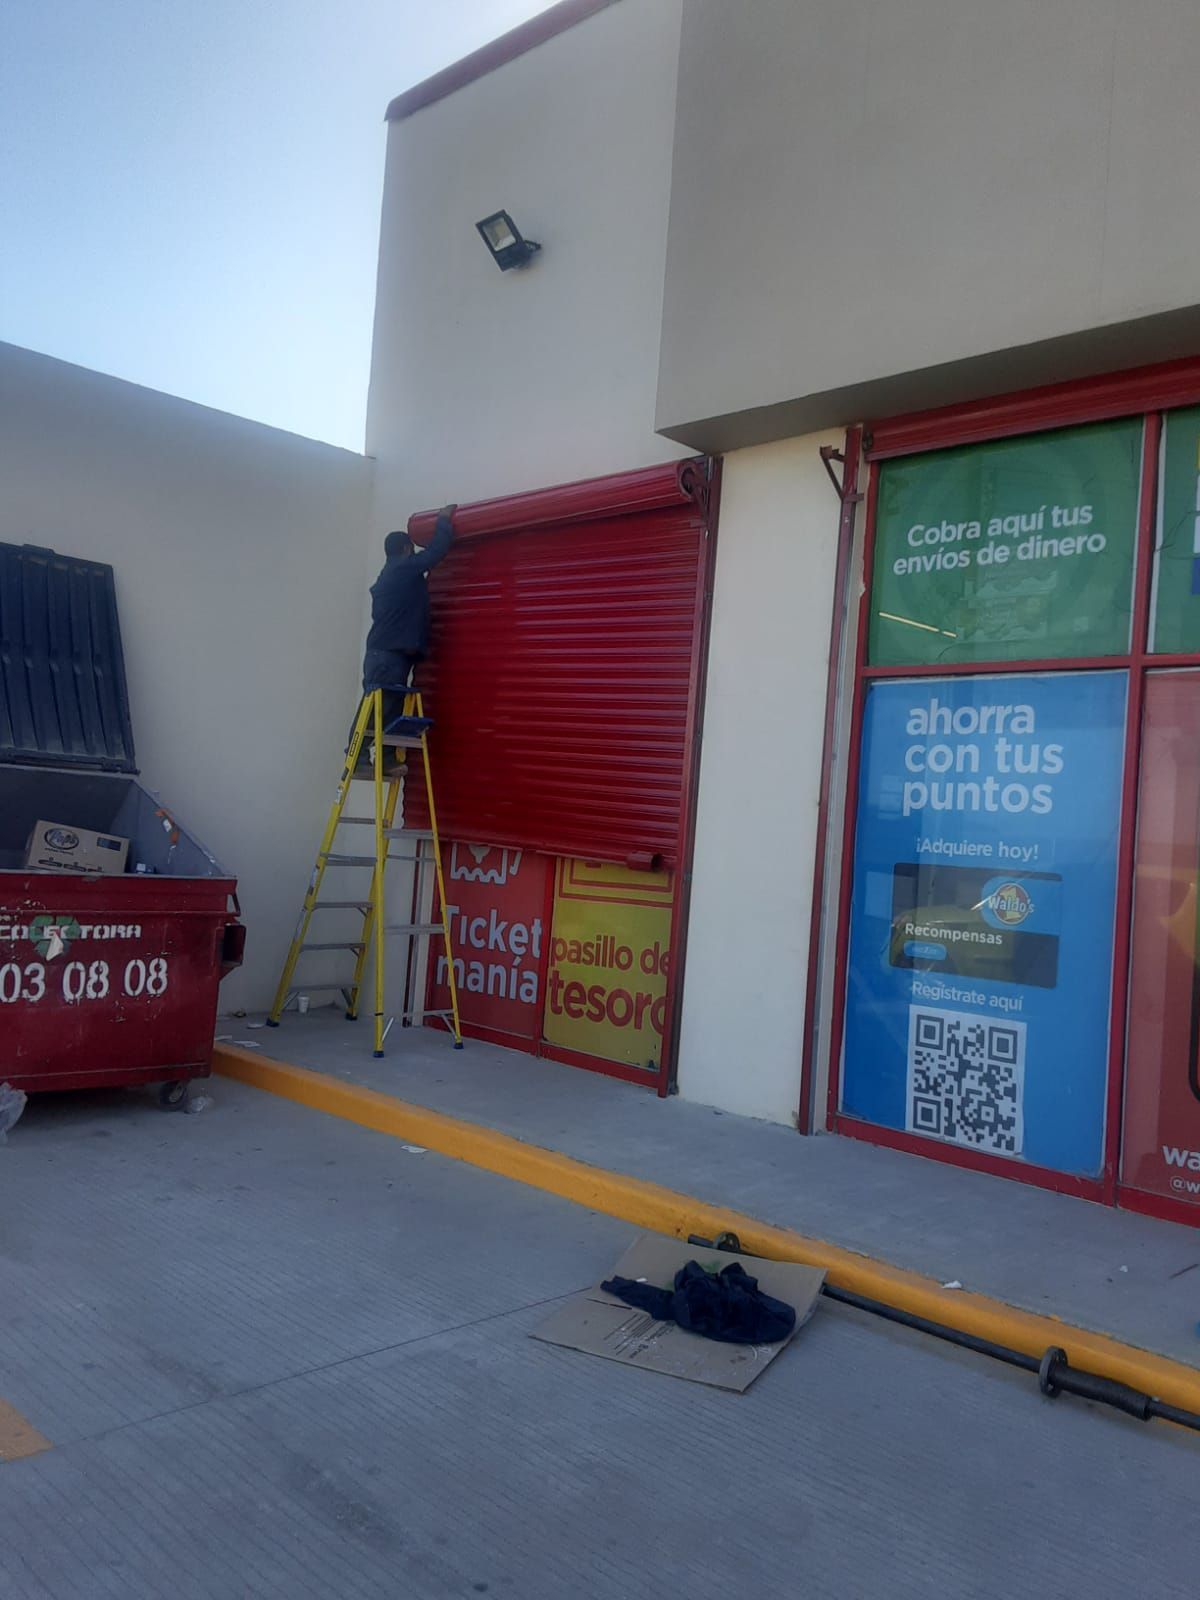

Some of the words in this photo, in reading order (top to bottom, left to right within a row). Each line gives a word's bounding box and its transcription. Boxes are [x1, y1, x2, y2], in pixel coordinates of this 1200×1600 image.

[907, 520, 981, 547] Cobra
[987, 505, 1047, 537] aquí
[1051, 505, 1093, 528] tus
[893, 548, 970, 575] envíos
[976, 541, 1010, 565] de
[1017, 534, 1106, 561] dinero
[906, 698, 1035, 735] ahorra
[904, 742, 979, 772] con
[995, 737, 1064, 774] tus
[902, 775, 1053, 816] puntos
[999, 841, 1039, 861] hoy!
[440, 904, 542, 959] Ticket
[905, 923, 1003, 945] Recompensas
[550, 935, 633, 971] pasillo
[0, 962, 45, 1003] 03
[63, 960, 109, 1002] 08
[124, 957, 168, 997] 08
[436, 955, 538, 1004] manía
